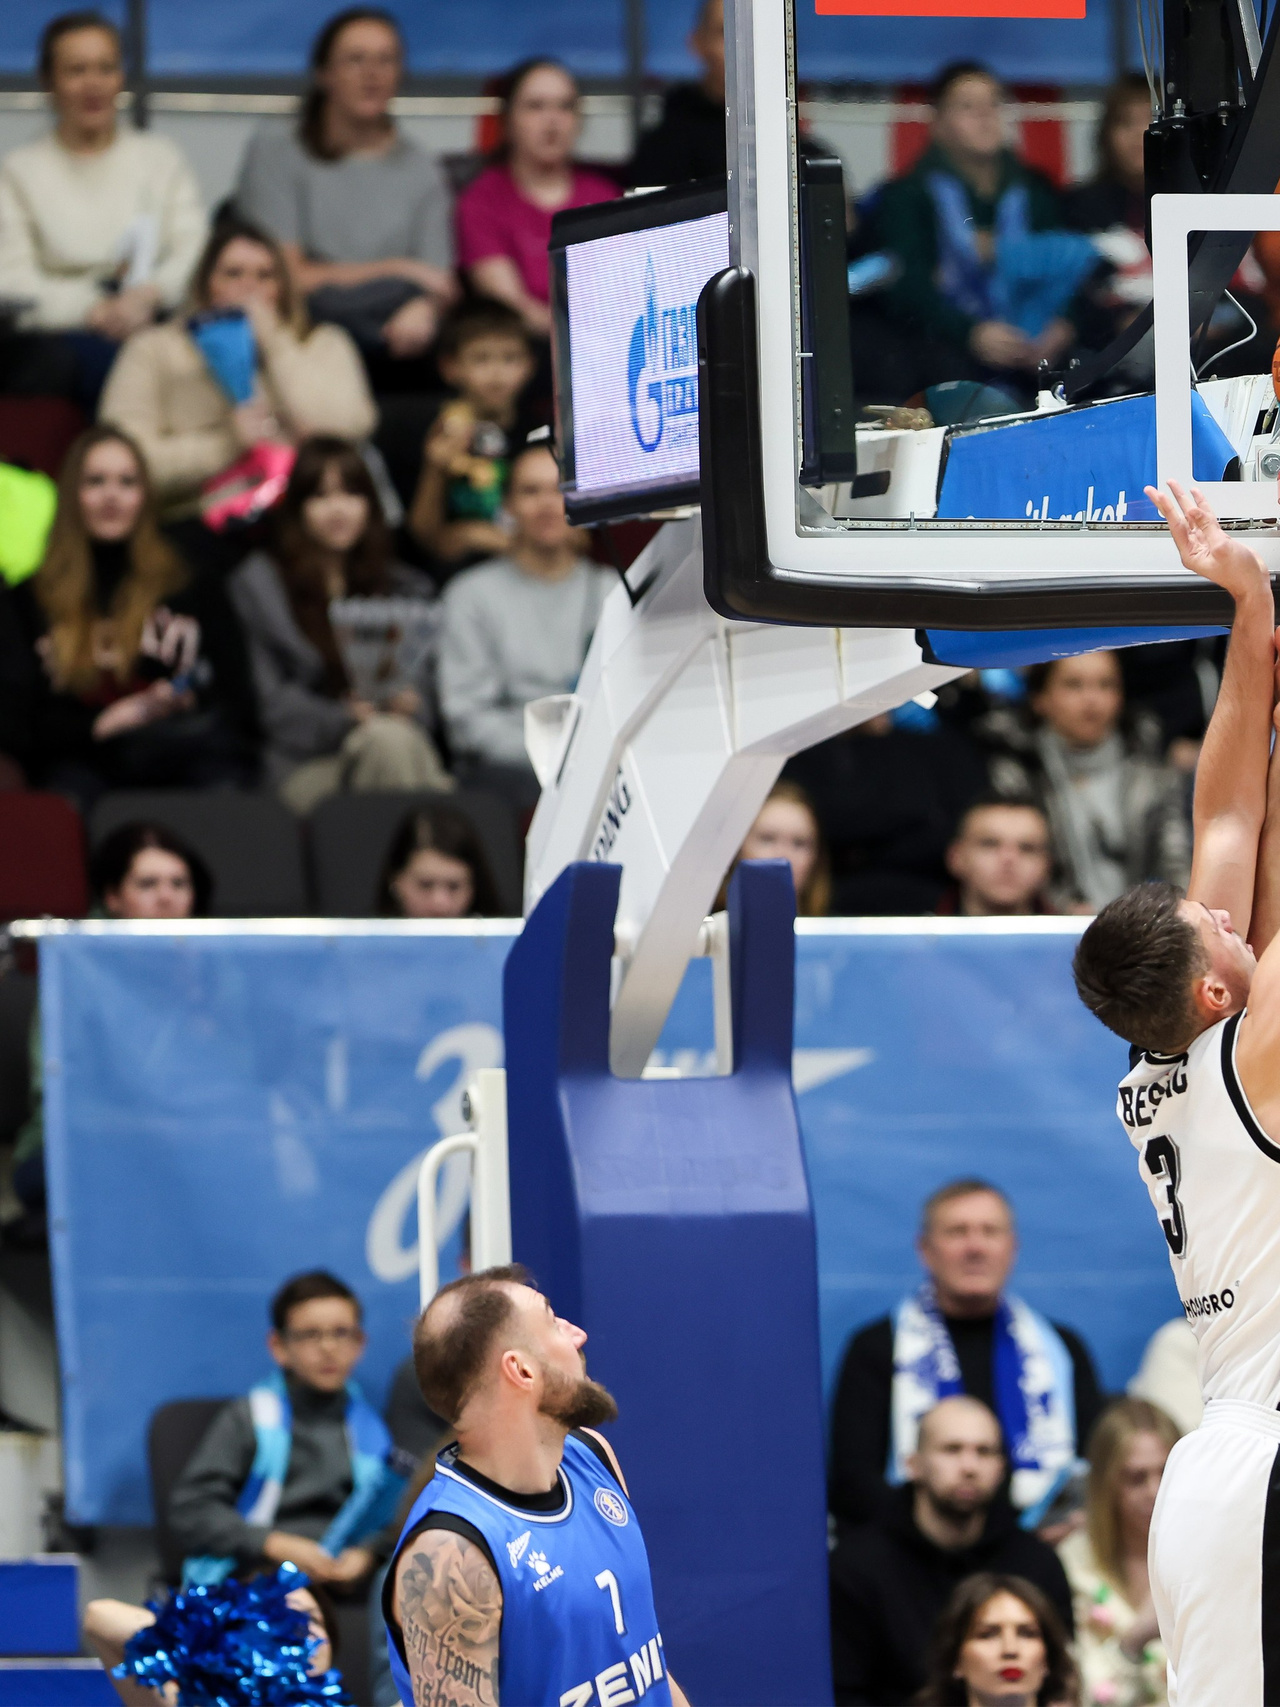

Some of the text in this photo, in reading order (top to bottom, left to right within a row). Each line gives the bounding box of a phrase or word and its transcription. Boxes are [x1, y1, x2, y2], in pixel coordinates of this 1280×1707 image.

[1145, 1135, 1188, 1259] 3
[532, 1565, 565, 1592] KELME
[594, 1568, 626, 1637] 7
[559, 1632, 664, 1707] ZENI
